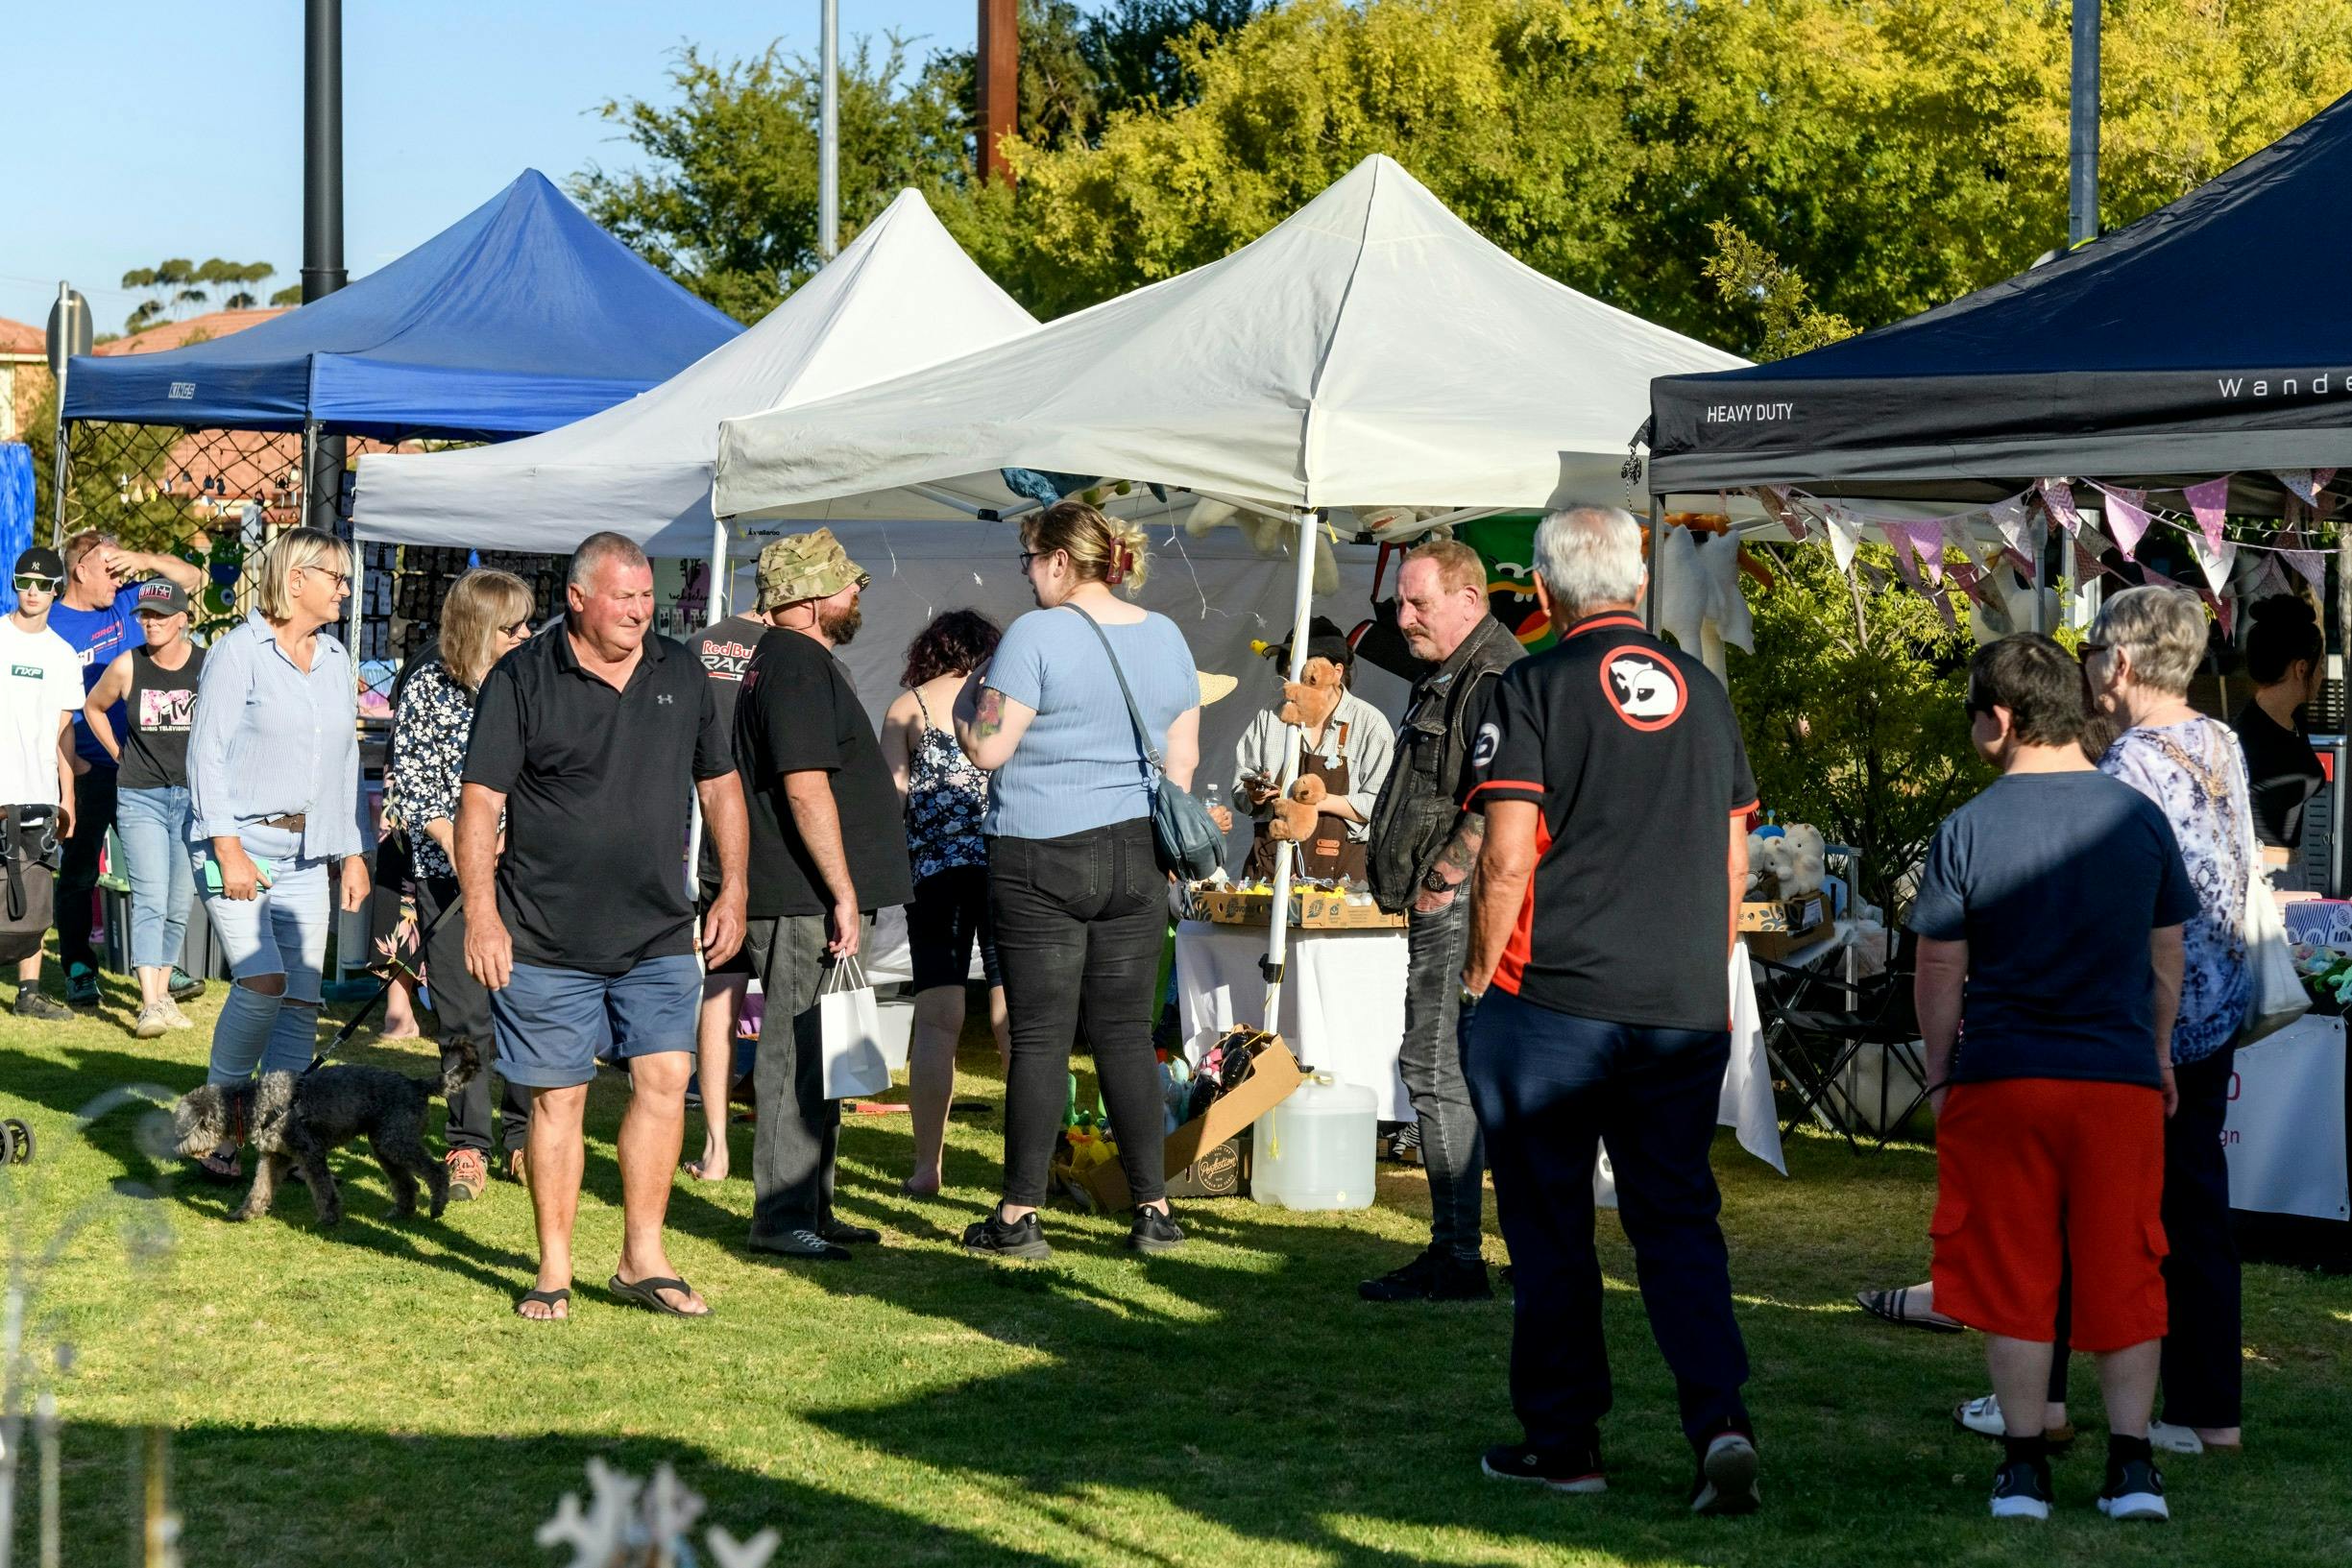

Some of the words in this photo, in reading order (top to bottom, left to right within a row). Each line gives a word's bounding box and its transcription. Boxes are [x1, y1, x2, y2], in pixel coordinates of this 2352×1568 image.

[1707, 404, 1753, 422] HEAVY
[1757, 402, 1793, 421] DUTY
[702, 639, 732, 656] Red
